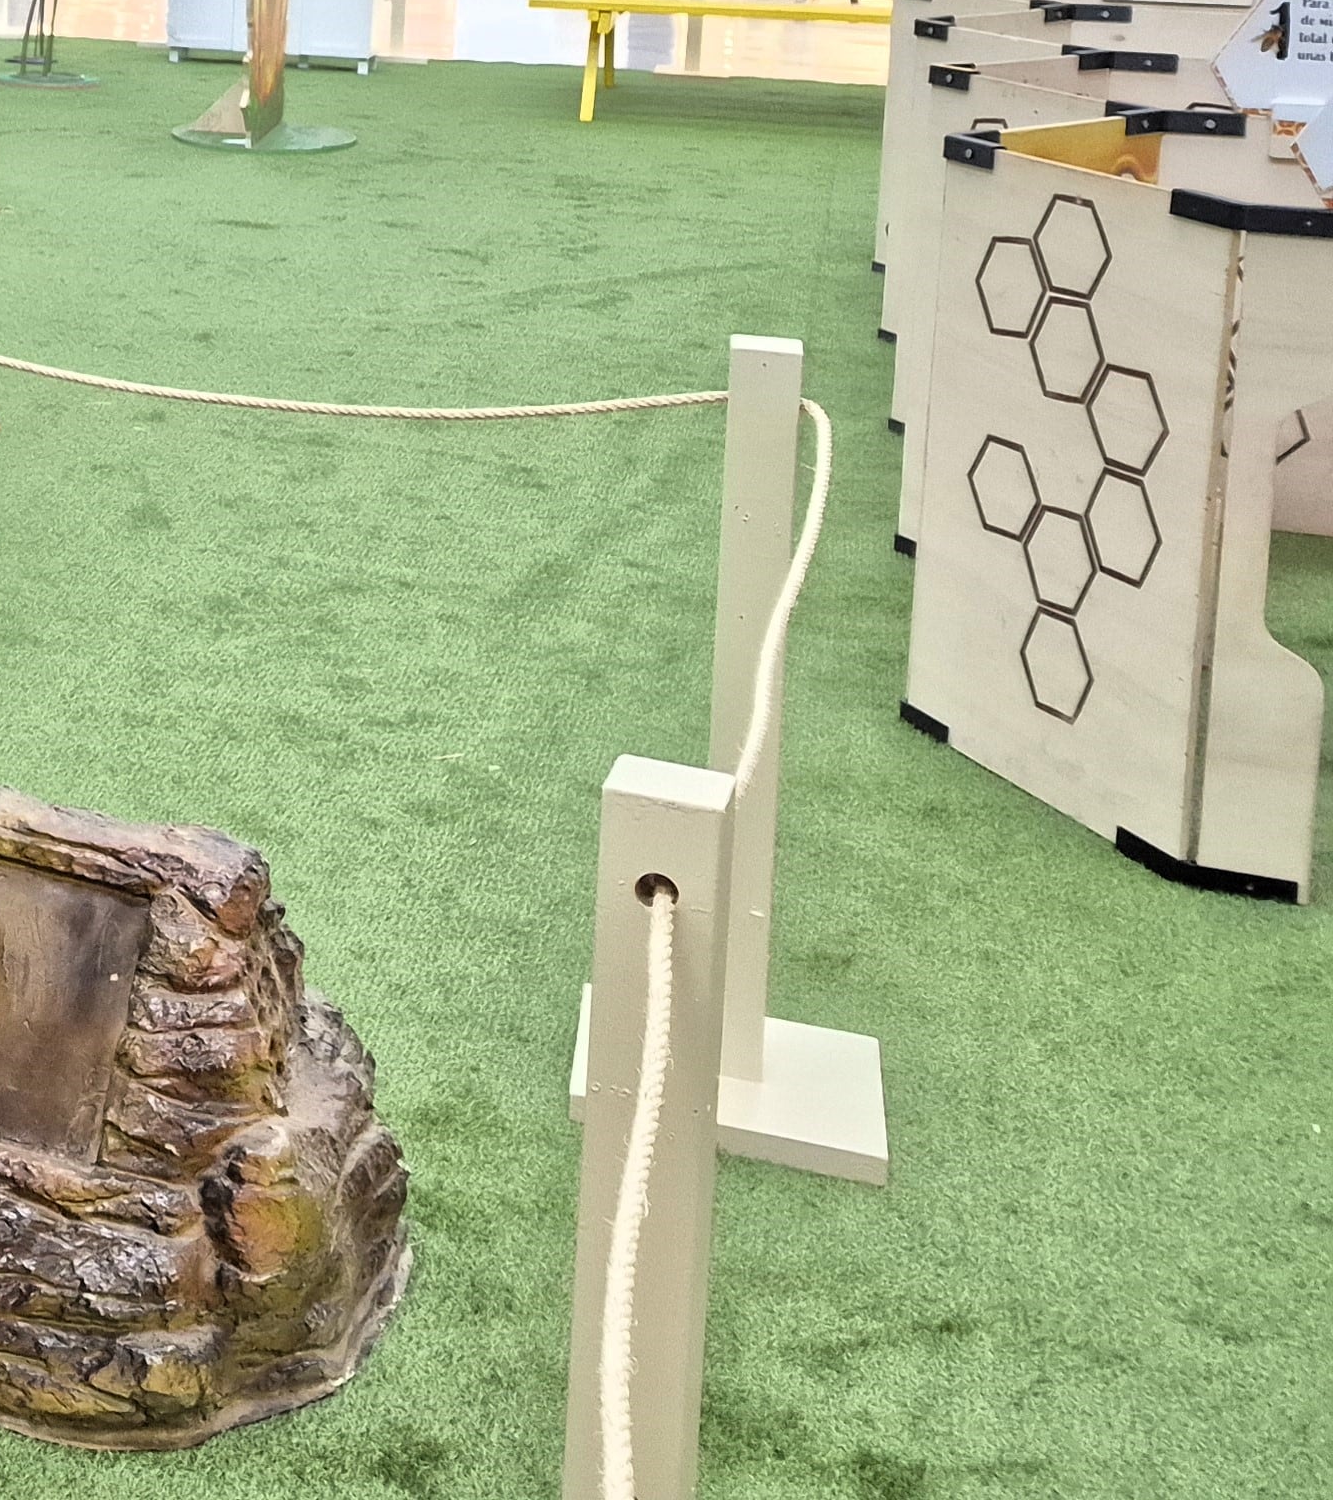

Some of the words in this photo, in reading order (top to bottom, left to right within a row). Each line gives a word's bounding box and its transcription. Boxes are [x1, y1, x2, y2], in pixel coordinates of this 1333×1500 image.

[1300, 15, 1315, 26] de
[1269, 1, 1291, 60] 1
[1299, 32, 1327, 44] total
[1297, 52, 1325, 61] unas
